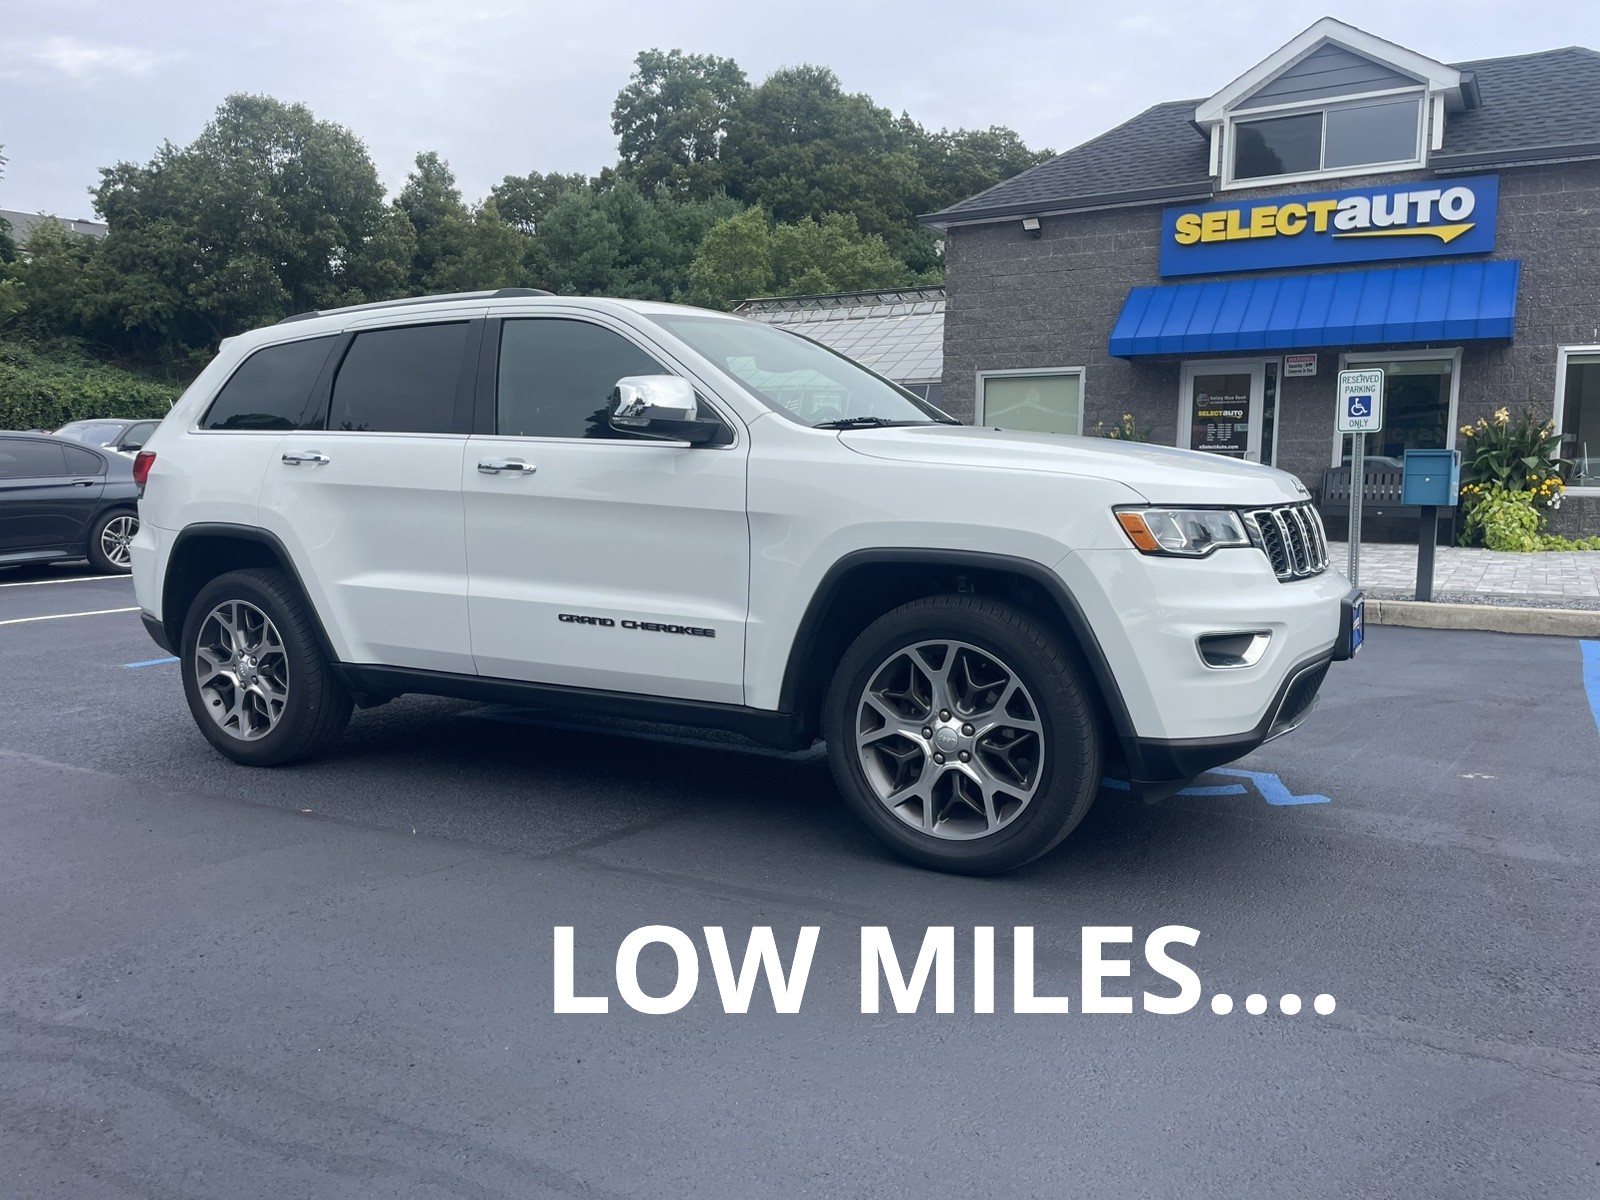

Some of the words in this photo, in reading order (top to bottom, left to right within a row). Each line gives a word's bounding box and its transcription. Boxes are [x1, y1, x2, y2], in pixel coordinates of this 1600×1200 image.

[1342, 374, 1379, 385] RESERVED
[1345, 385, 1376, 394] PARKING
[1349, 419, 1369, 427] ONLY
[558, 613, 615, 627] GRAND
[621, 620, 716, 638] CHEROKEE
